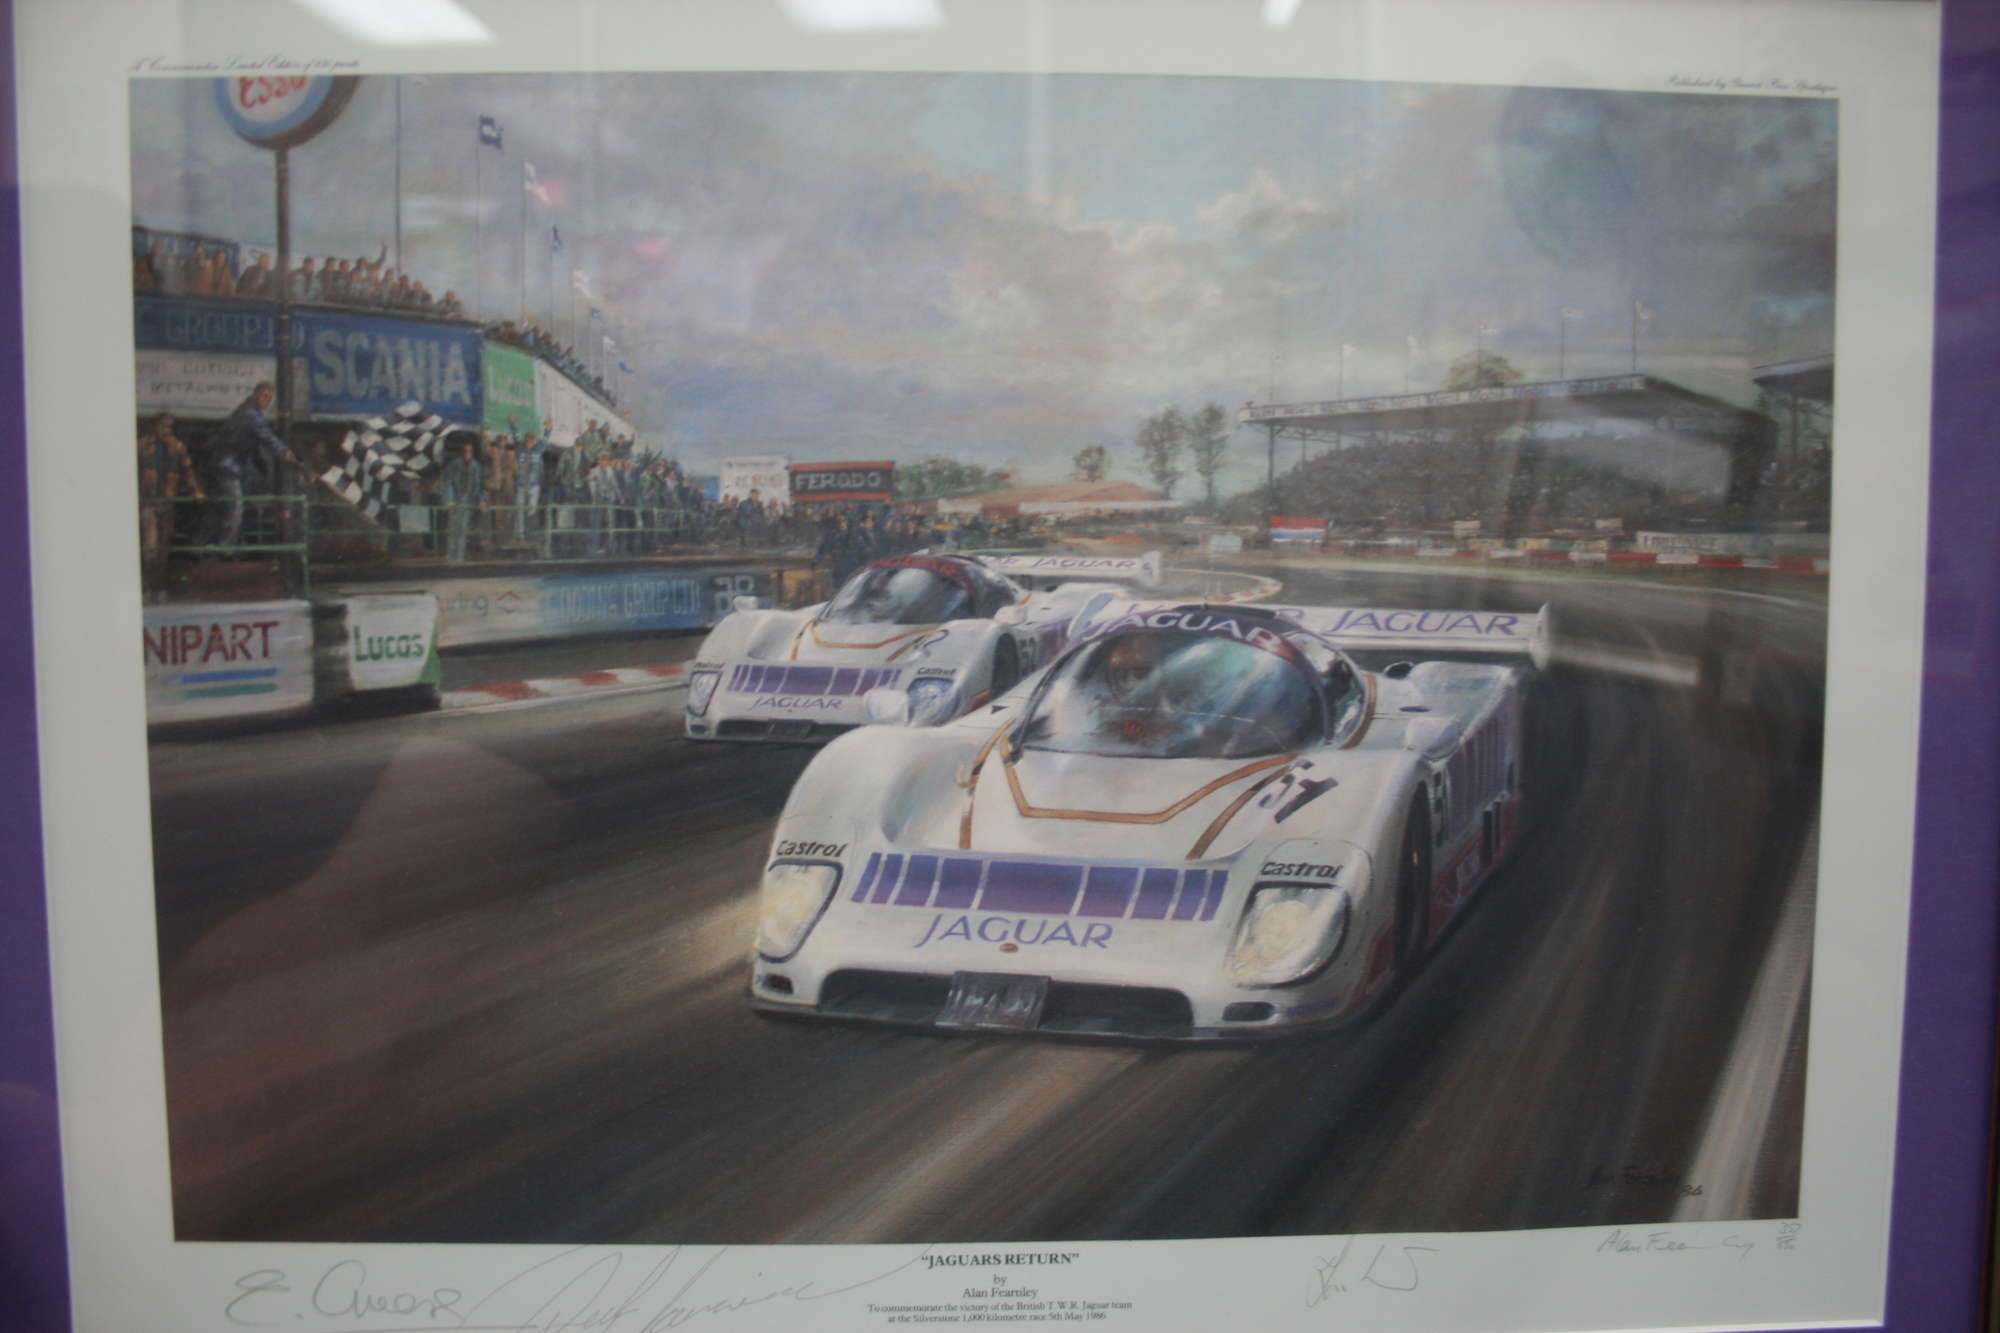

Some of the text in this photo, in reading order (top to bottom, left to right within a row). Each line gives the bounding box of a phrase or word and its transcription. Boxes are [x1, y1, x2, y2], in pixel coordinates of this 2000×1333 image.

[314, 330, 472, 405] SCANIA
[794, 471, 881, 491] FERODO
[1031, 558, 1137, 569] JAGUAR
[1083, 611, 1282, 647] JAGUAR
[1329, 609, 1520, 636] JAGUAR
[353, 625, 424, 662] Lucas
[750, 697, 843, 711] JAGUAR
[776, 840, 848, 859] Castrol
[1260, 861, 1343, 879] Castrol
[913, 914, 1114, 950] JAGUAR
[921, 1253, 1080, 1269] “JAGUARS RETURN”
[993, 1274, 1007, 1286] by
[962, 1287, 1038, 1300] Alan Fearnley
[867, 1303, 880, 1313] To
[880, 1303, 943, 1312] commemorate
[944, 1303, 958, 1311] the
[961, 1303, 988, 1314] victory
[990, 1302, 1001, 1311] of
[1001, 1302, 1016, 1310] the
[1017, 1301, 1046, 1310] British
[1082, 1301, 1110, 1311] Jaguar
[1111, 1301, 1133, 1309] team
[887, 1314, 896, 1323] at
[897, 1313, 912, 1322] the
[912, 1312, 960, 1322] Silverstone
[962, 1311, 986, 1321] 1,000
[1029, 1312, 1046, 1320] race
[1048, 1310, 1063, 1320] 5th
[1065, 1310, 1084, 1322] May
[1086, 1310, 1106, 1320] 1986
